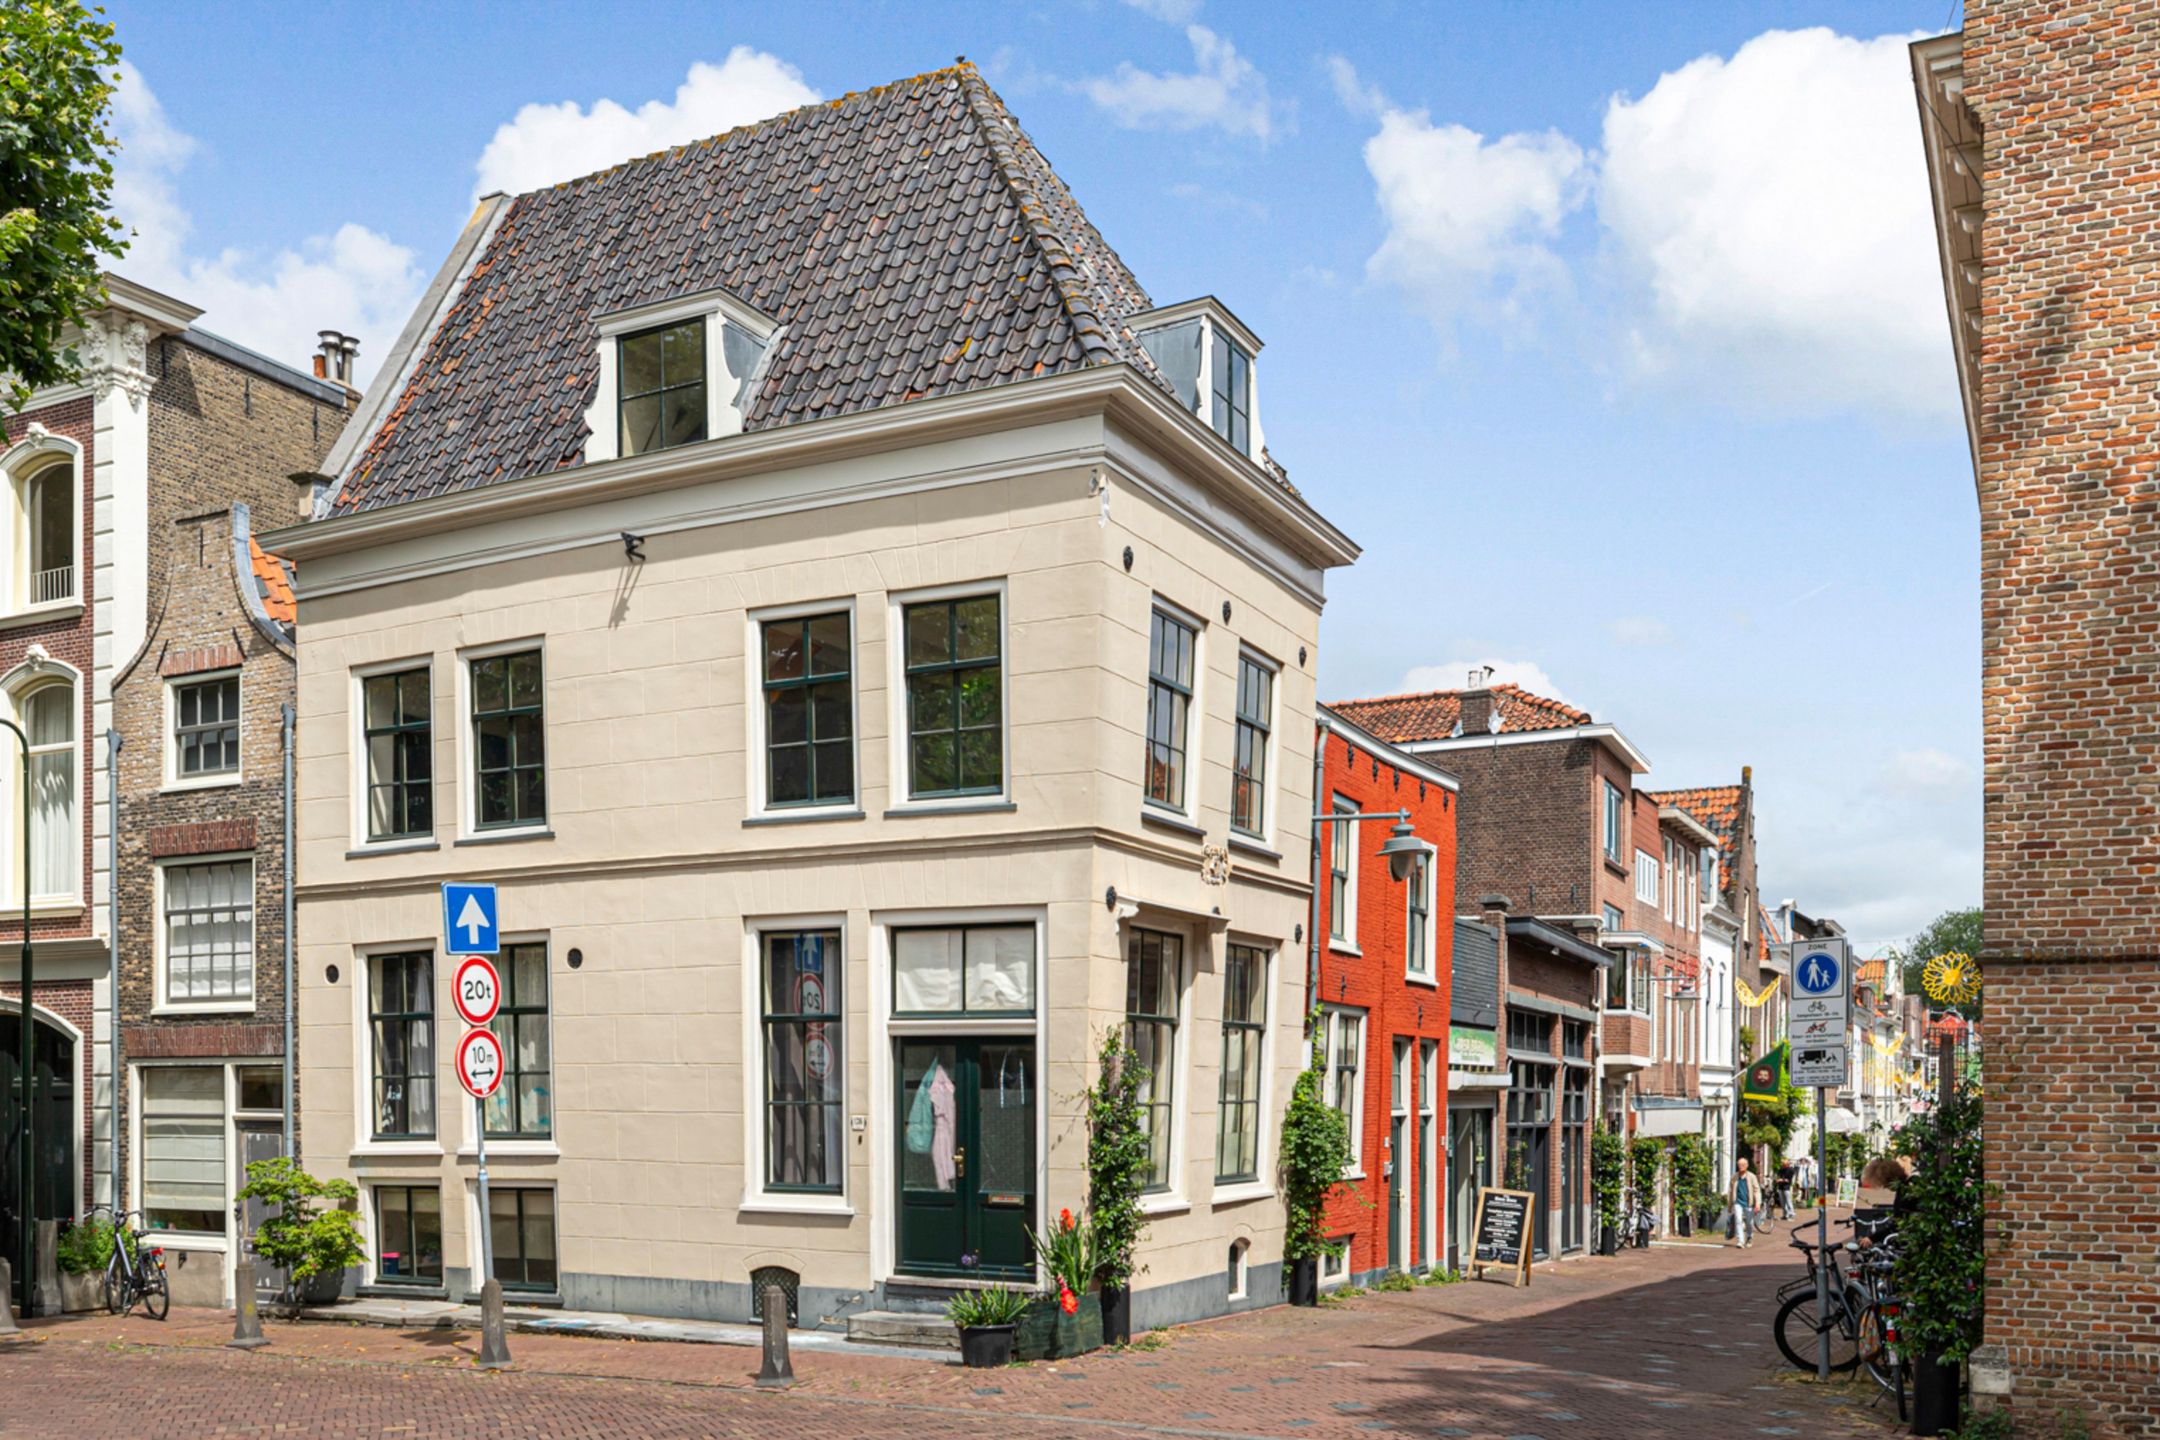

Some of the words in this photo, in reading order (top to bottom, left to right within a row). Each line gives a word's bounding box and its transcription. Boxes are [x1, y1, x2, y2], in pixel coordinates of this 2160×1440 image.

[1808, 943, 1827, 951] ZONE
[464, 980, 492, 1000] 20t
[472, 1046, 494, 1064] 10m
